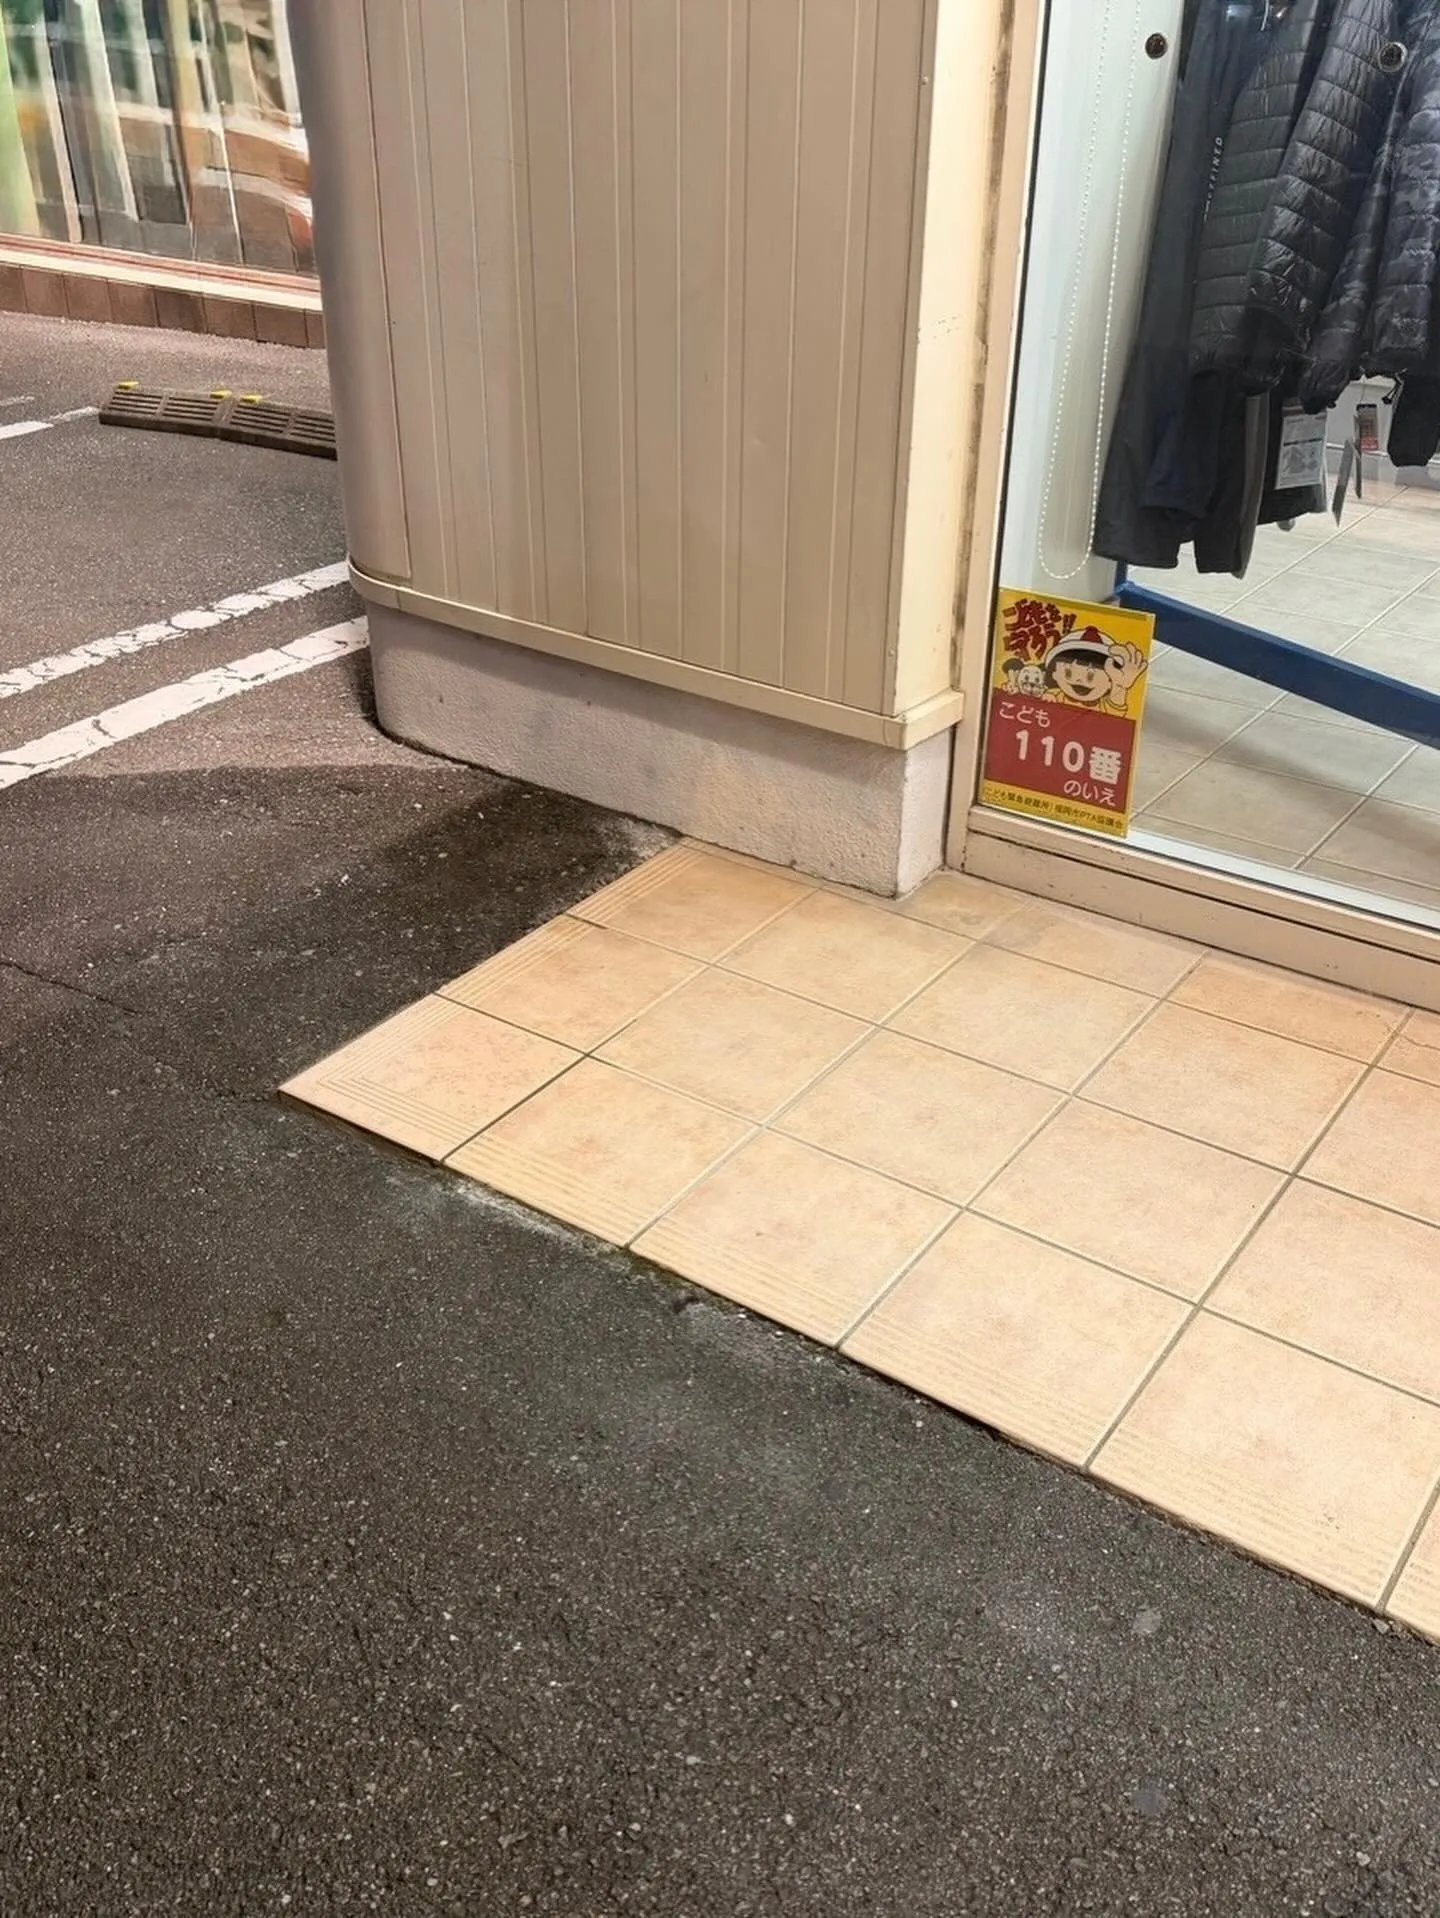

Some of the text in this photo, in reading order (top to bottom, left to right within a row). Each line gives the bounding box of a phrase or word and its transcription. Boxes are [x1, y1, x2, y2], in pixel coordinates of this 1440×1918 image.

[1000, 702, 1050, 728] こども
[1016, 729, 1121, 785] 110番
[1064, 780, 1116, 806] のいえ
